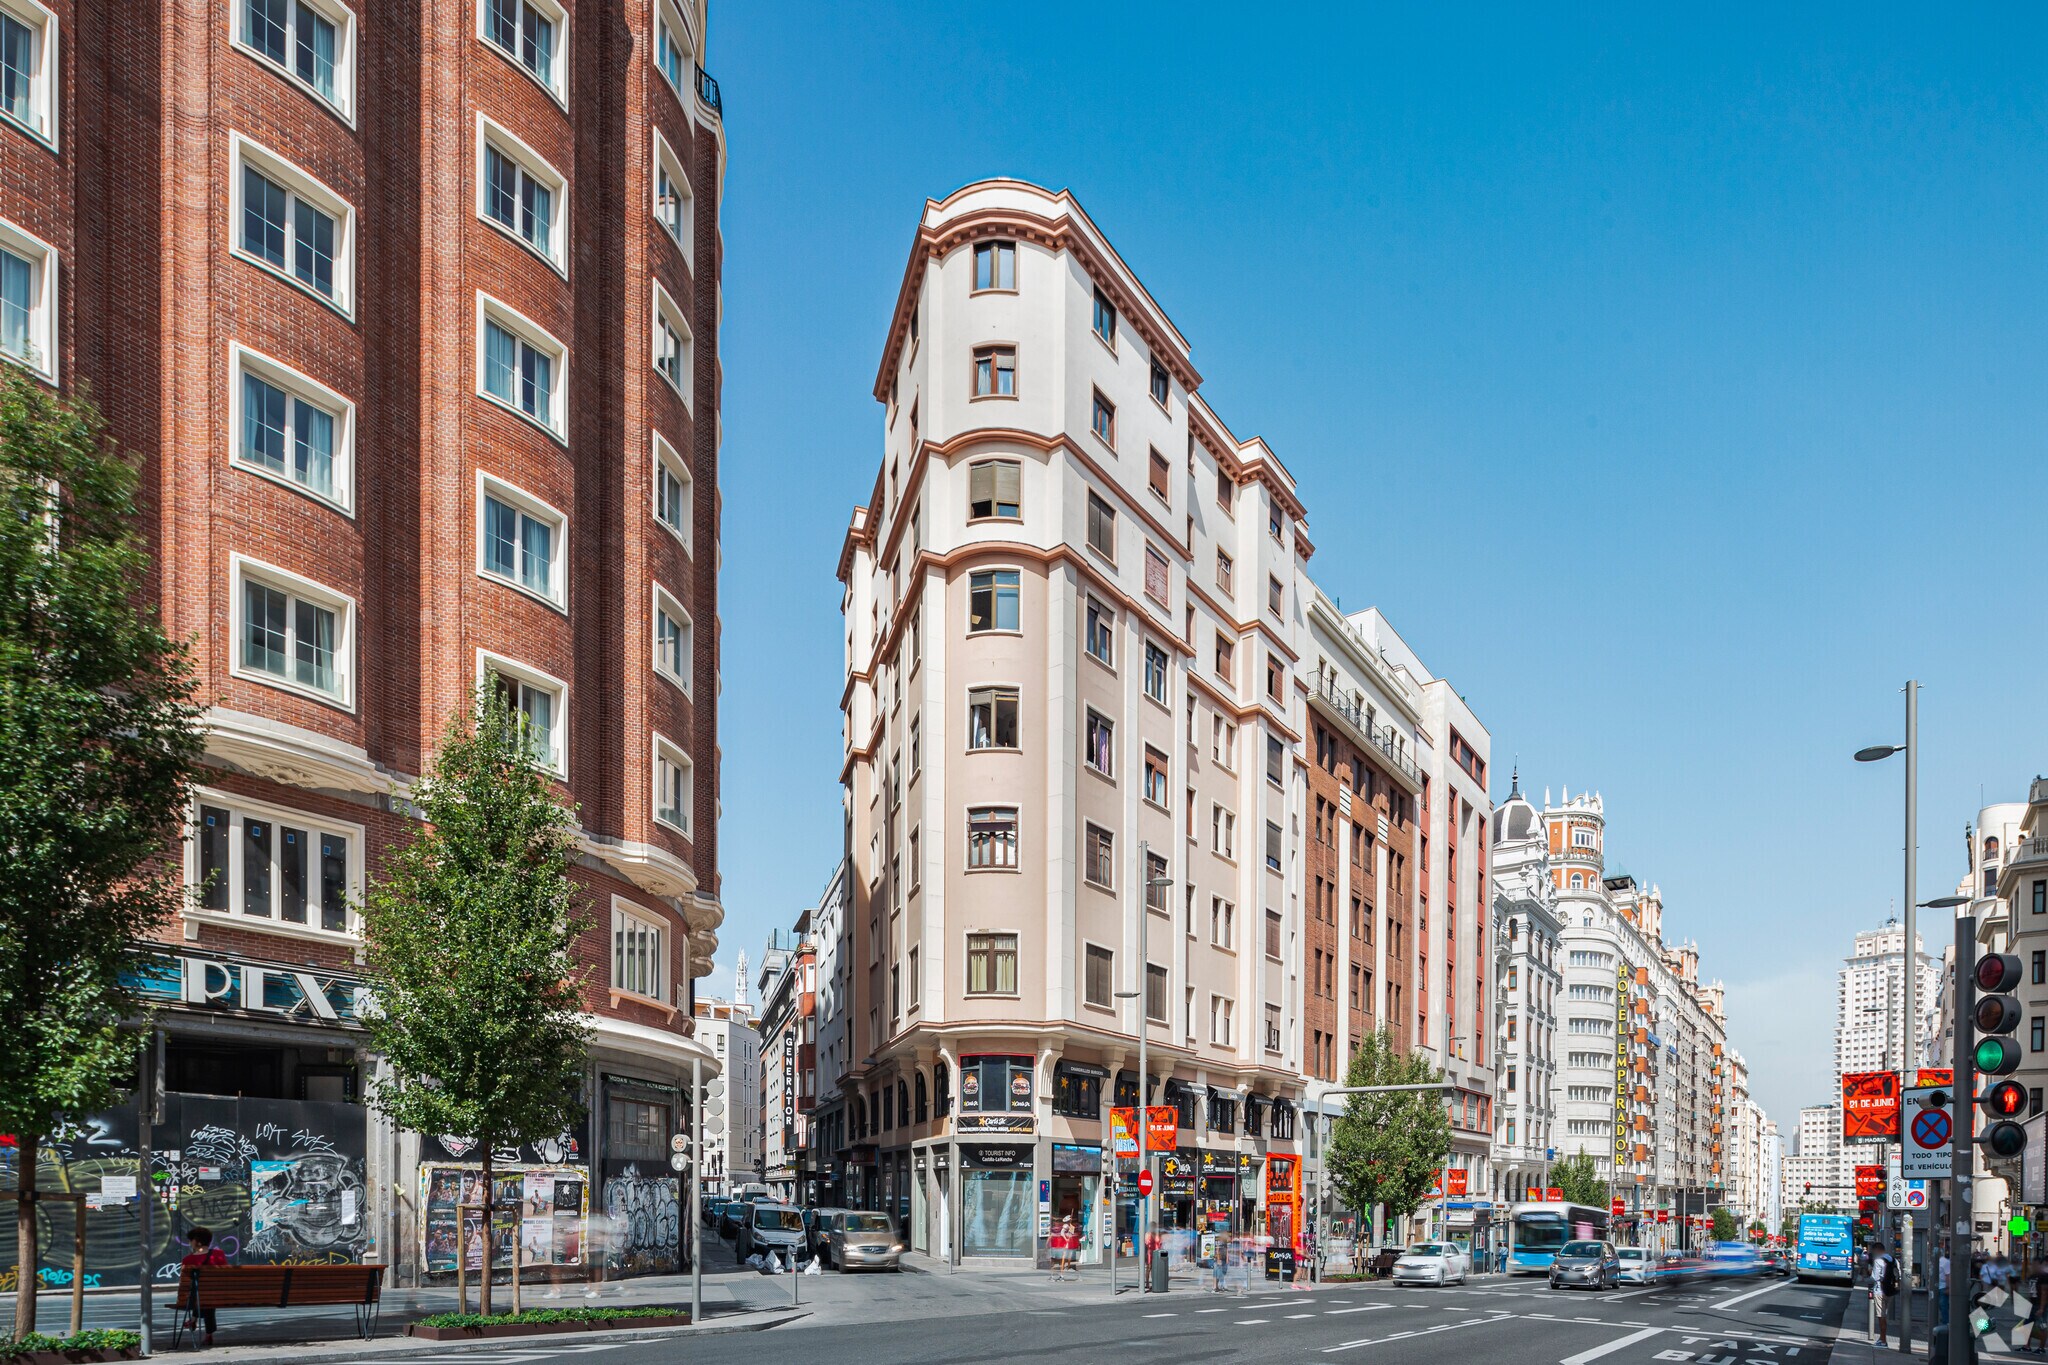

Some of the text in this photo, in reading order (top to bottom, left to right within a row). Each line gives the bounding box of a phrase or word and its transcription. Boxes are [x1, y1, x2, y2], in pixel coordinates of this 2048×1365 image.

[181, 957, 338, 1020] REX
[1615, 965, 1628, 1165] HOTEL EMPERADOR
[608, 1075, 627, 1083] MODAS
[785, 1037, 793, 1125] GENERATOR
[658, 1084, 679, 1092] COSTURA
[1850, 1097, 1895, 1108] 21 DE JUNIO
[1906, 1097, 1919, 1106] EN
[1680, 1335, 1800, 1357] TAXI
